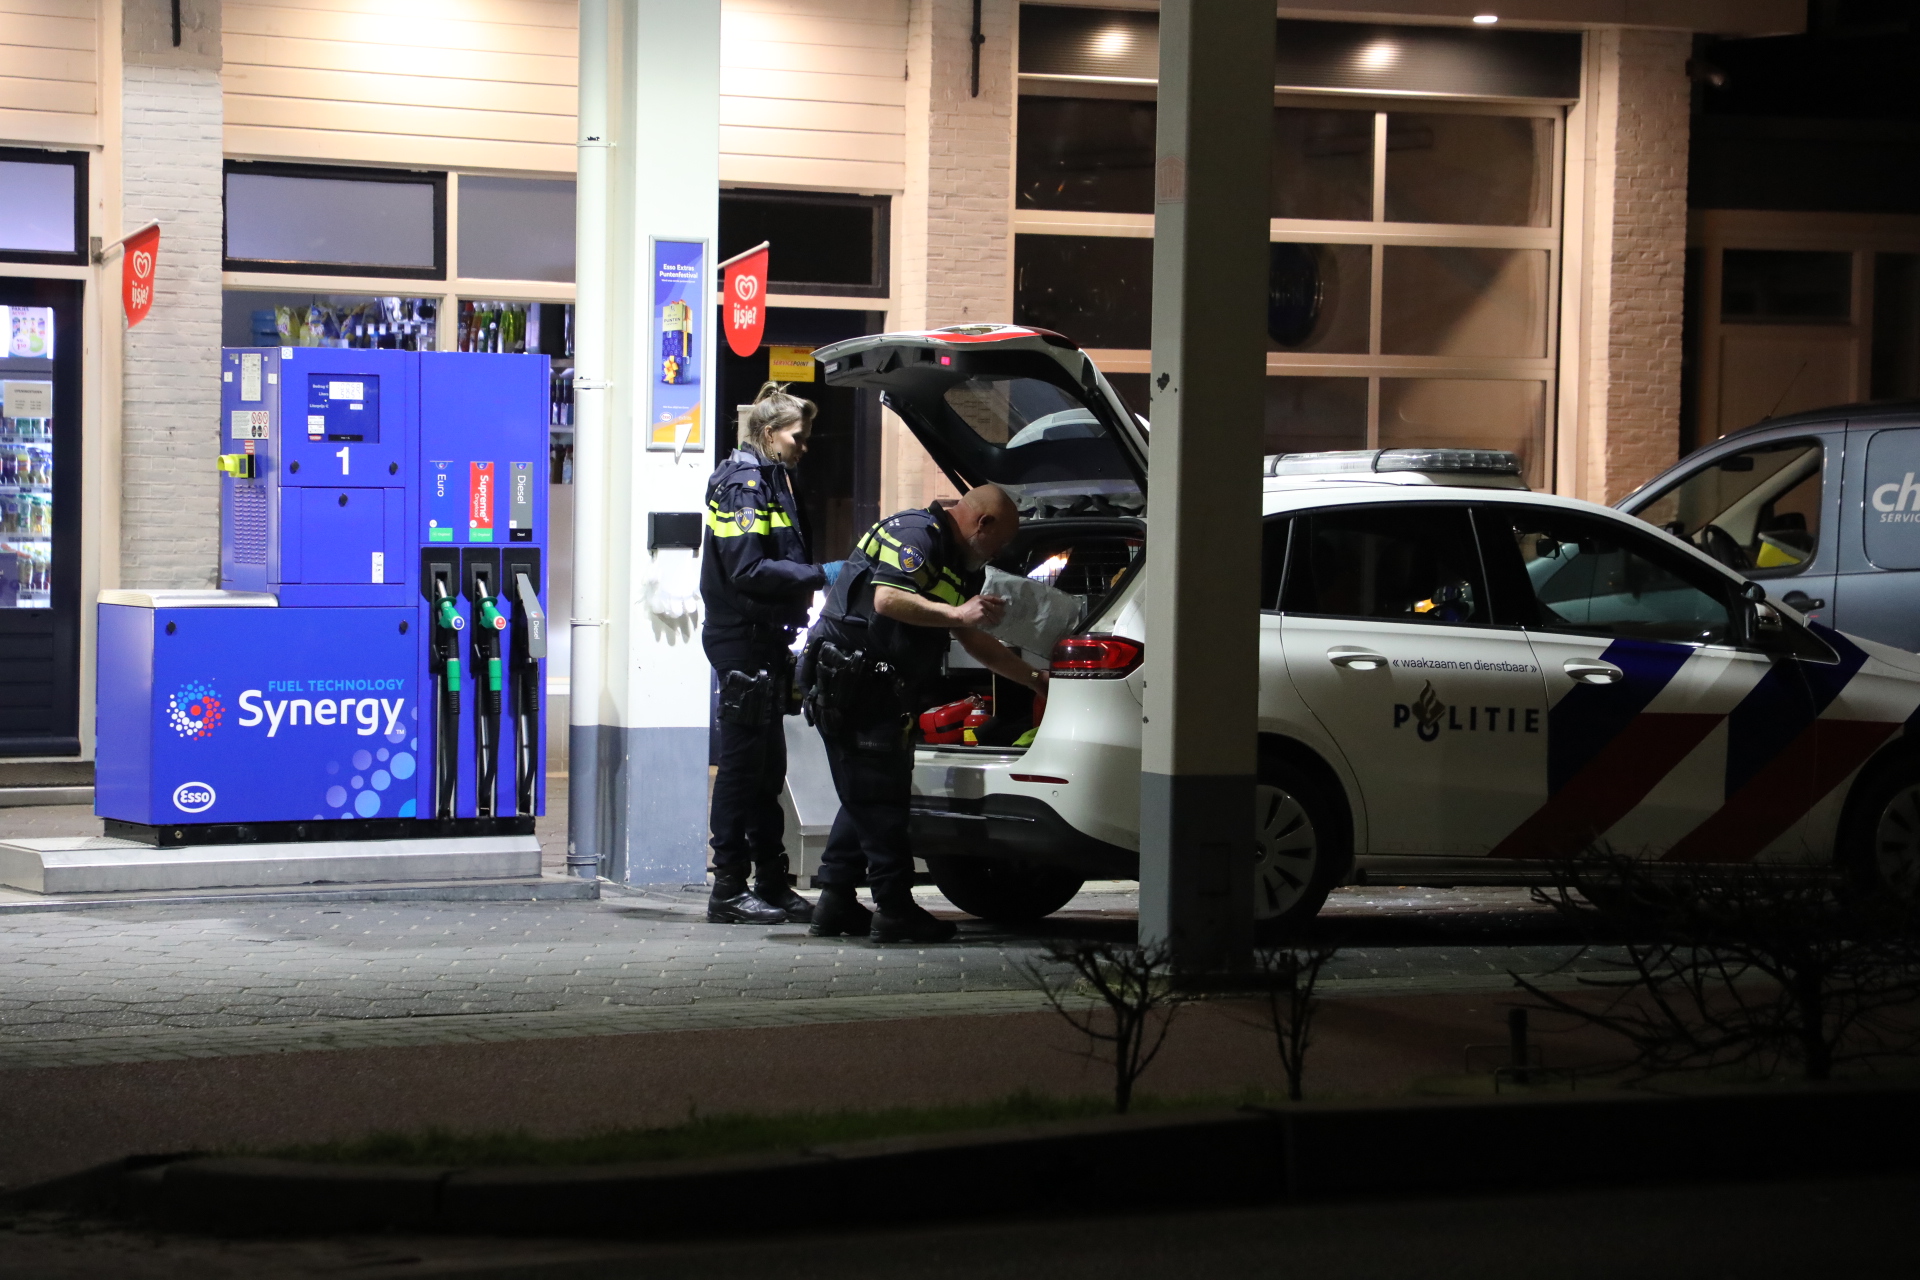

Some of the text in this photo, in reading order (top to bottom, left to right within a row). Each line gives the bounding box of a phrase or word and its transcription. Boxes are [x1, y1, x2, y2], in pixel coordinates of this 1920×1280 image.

[659, 270, 699, 279] Puntenfestival
[663, 263, 695, 272] Esso Extras
[132, 280, 149, 309] ijsje?
[733, 302, 757, 330] ijsje?
[336, 447, 349, 475] 1
[437, 474, 446, 497] Euro
[517, 475, 527, 504] Diesel
[1400, 658, 1458, 670] waakzaam
[1458, 662, 1472, 670] en
[1474, 660, 1529, 673] dienstbaar
[268, 679, 404, 692] FUEL TECHNOLOGY
[238, 689, 405, 738] Synergy
[1393, 703, 1540, 742] POLITIE
